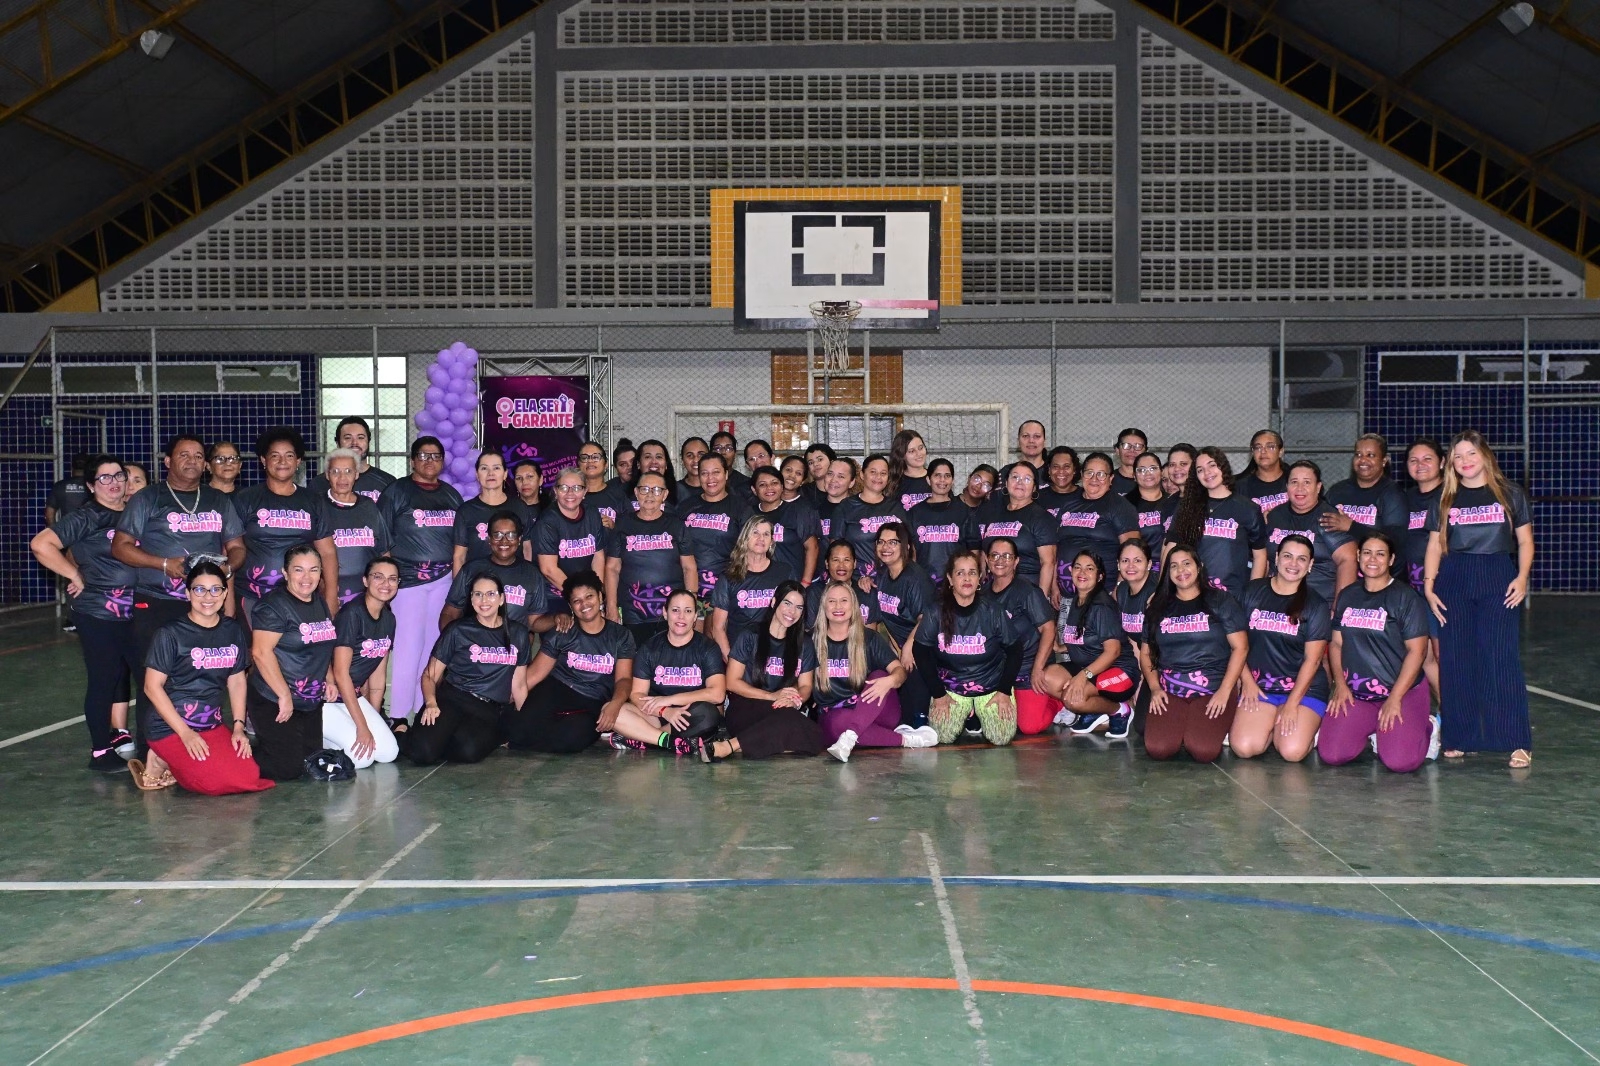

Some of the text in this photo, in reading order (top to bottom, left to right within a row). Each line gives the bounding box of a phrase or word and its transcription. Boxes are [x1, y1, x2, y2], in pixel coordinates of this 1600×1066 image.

[514, 399, 554, 412] ELA SE
[512, 413, 573, 428] GARANTE
[1344, 506, 1367, 514] ELA SE
[1461, 506, 1490, 515] ELA SE
[198, 512, 210, 520] SE
[1460, 514, 1504, 524] GARANTE
[180, 522, 221, 532] GARANTE
[270, 519, 310, 530] GARANTE
[692, 520, 728, 531] GARANTE
[1214, 520, 1225, 528] SE
[924, 533, 958, 542] GARANTE
[336, 538, 374, 547] GARANTE
[635, 541, 673, 550] GARANTE
[504, 586, 512, 594] SE
[748, 590, 772, 598] ELA SE
[748, 599, 770, 608] GARA
[1260, 611, 1286, 622] ELA SE
[1352, 608, 1374, 617] ELA SE
[1170, 622, 1209, 632] GARANTE
[1346, 617, 1384, 630] GARANTE
[963, 636, 973, 644] SE
[204, 648, 230, 657] ELA SE
[577, 654, 602, 664] ELA SE
[574, 661, 612, 674] GARANTE
[664, 667, 690, 676] ELA SE
[662, 676, 702, 686] GARANTE
